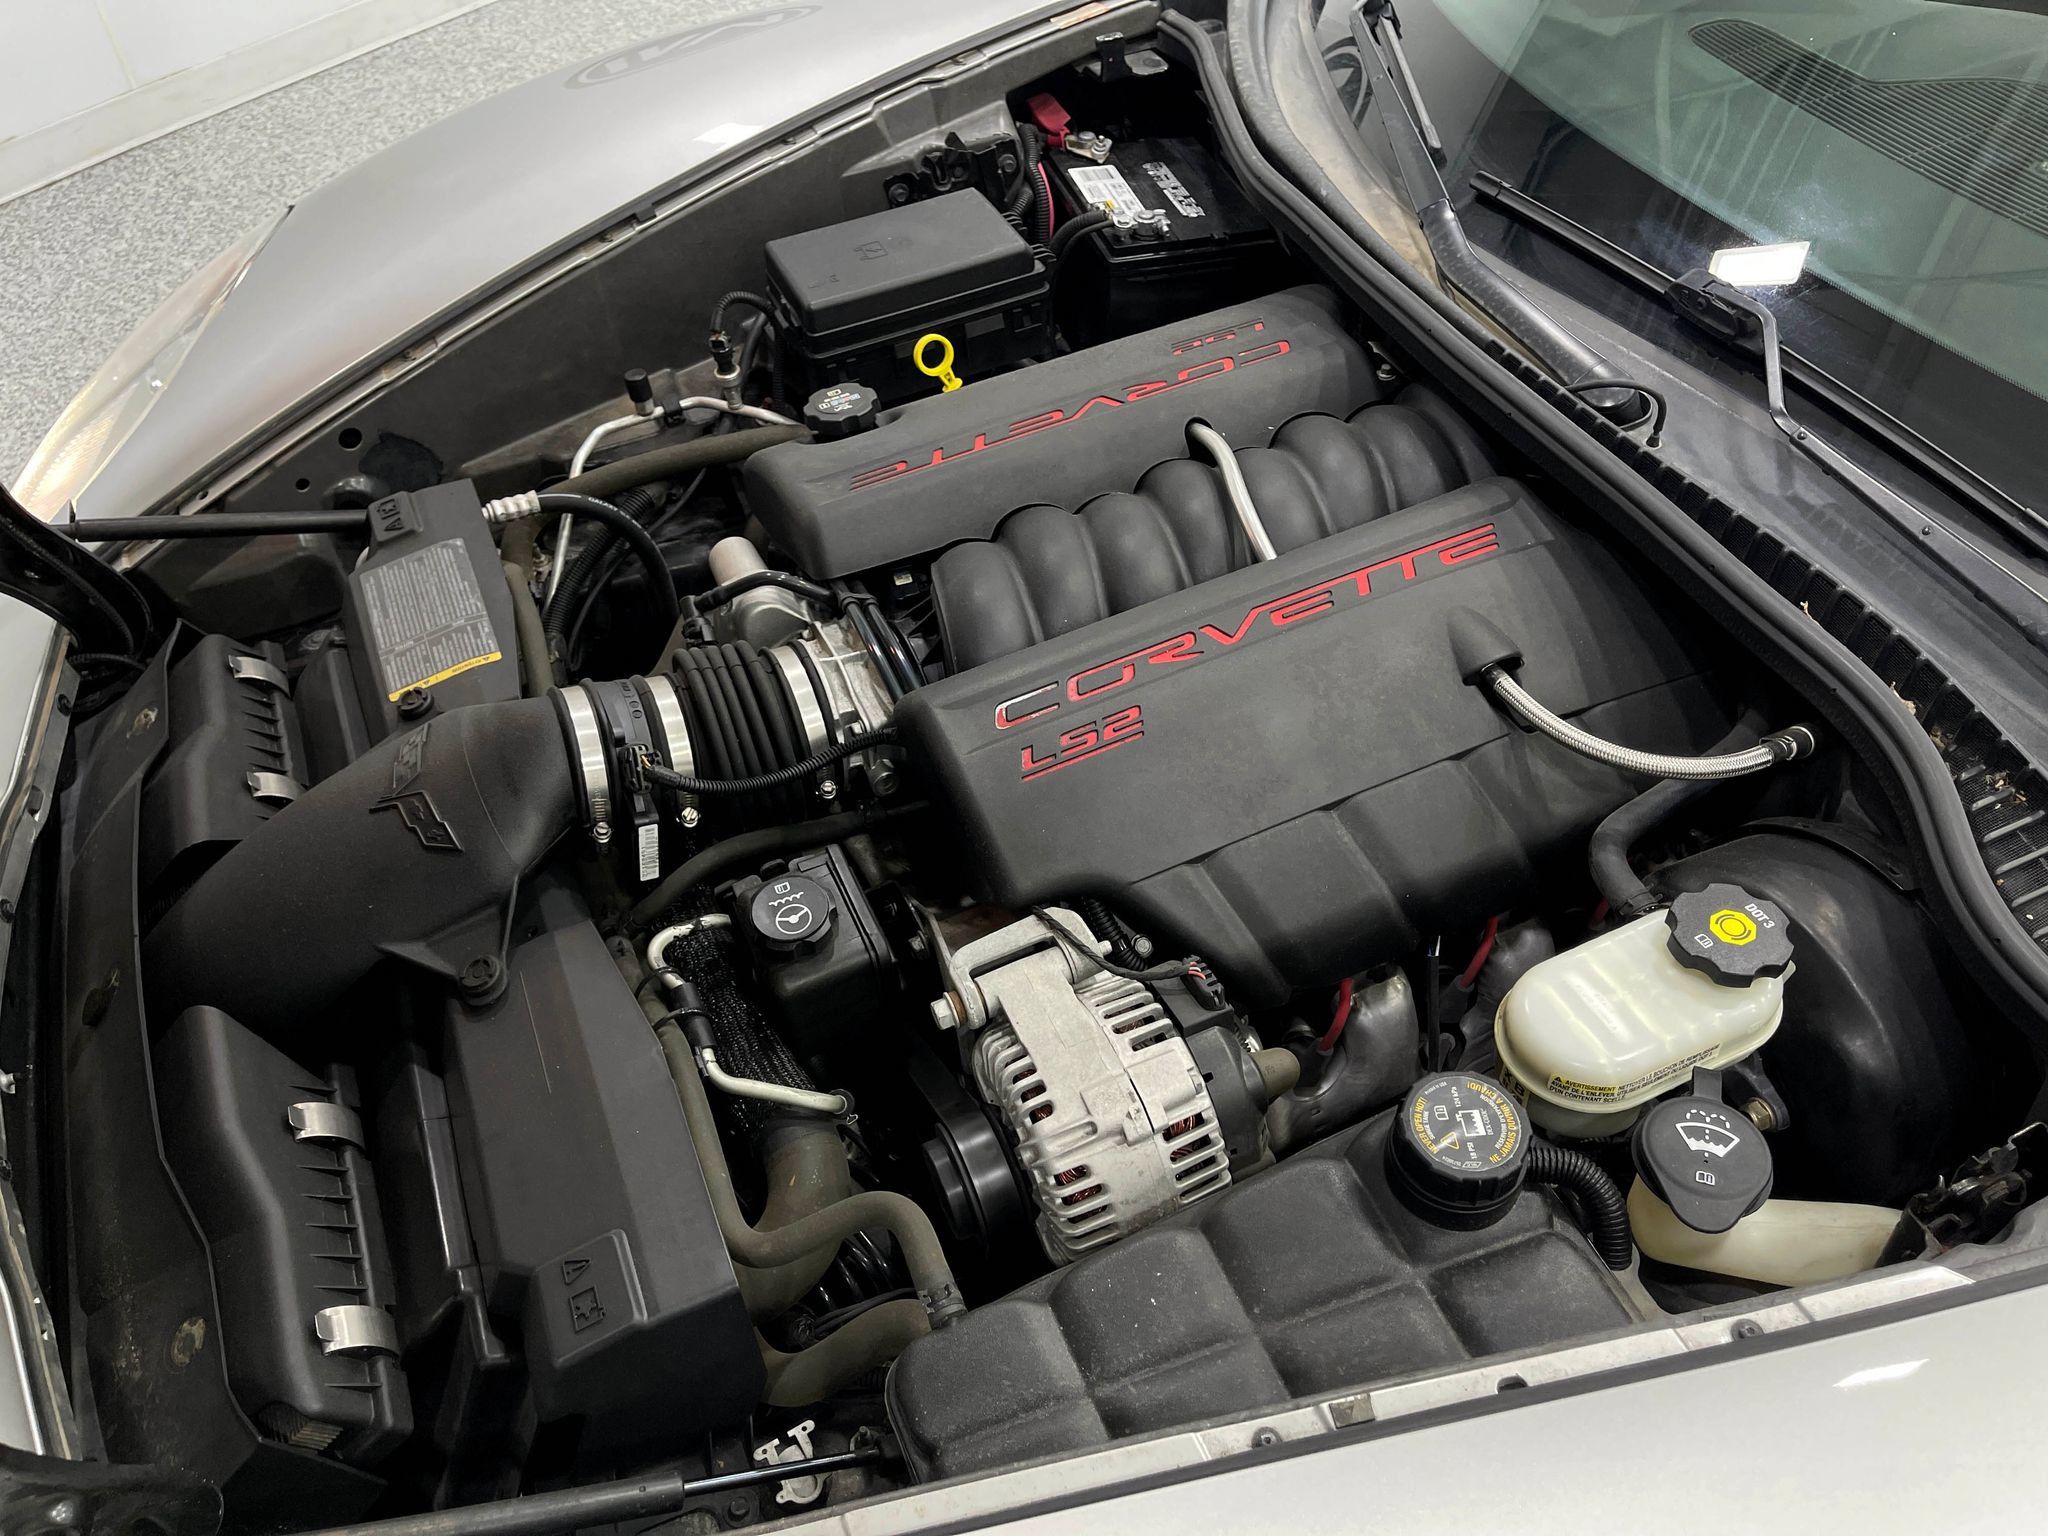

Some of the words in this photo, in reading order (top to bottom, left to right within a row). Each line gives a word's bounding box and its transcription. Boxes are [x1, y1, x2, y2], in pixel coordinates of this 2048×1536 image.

[1171, 321, 1264, 356] LS2
[849, 339, 1291, 492] CORVETTE
[994, 523, 1498, 730] CORVETTE
[1020, 704, 1144, 772] LS2
[1744, 903, 1770, 922] DOT
[1763, 920, 1776, 929] 3
[1552, 1080, 1570, 1090] AVANT
[1565, 1080, 1616, 1092] AVERTISSEMENT
[1618, 1077, 1645, 1091] NETTOYER
[1654, 1062, 1678, 1078] BOUCHON
[1452, 1097, 1462, 1108] 124
[1467, 1081, 1498, 1101] CHAUD!
[1564, 1092, 1602, 1102] CONTENANT
[1414, 1096, 1428, 1114] HOT!
[1500, 1103, 1516, 1130] OUVRIR
[1414, 1112, 1424, 1132] OPEN
[1420, 1131, 1440, 1154] NEVER
[1466, 1142, 1476, 1153] PSI
[1500, 1130, 1517, 1156] JAMAIS
[1489, 1154, 1501, 1164] NE
